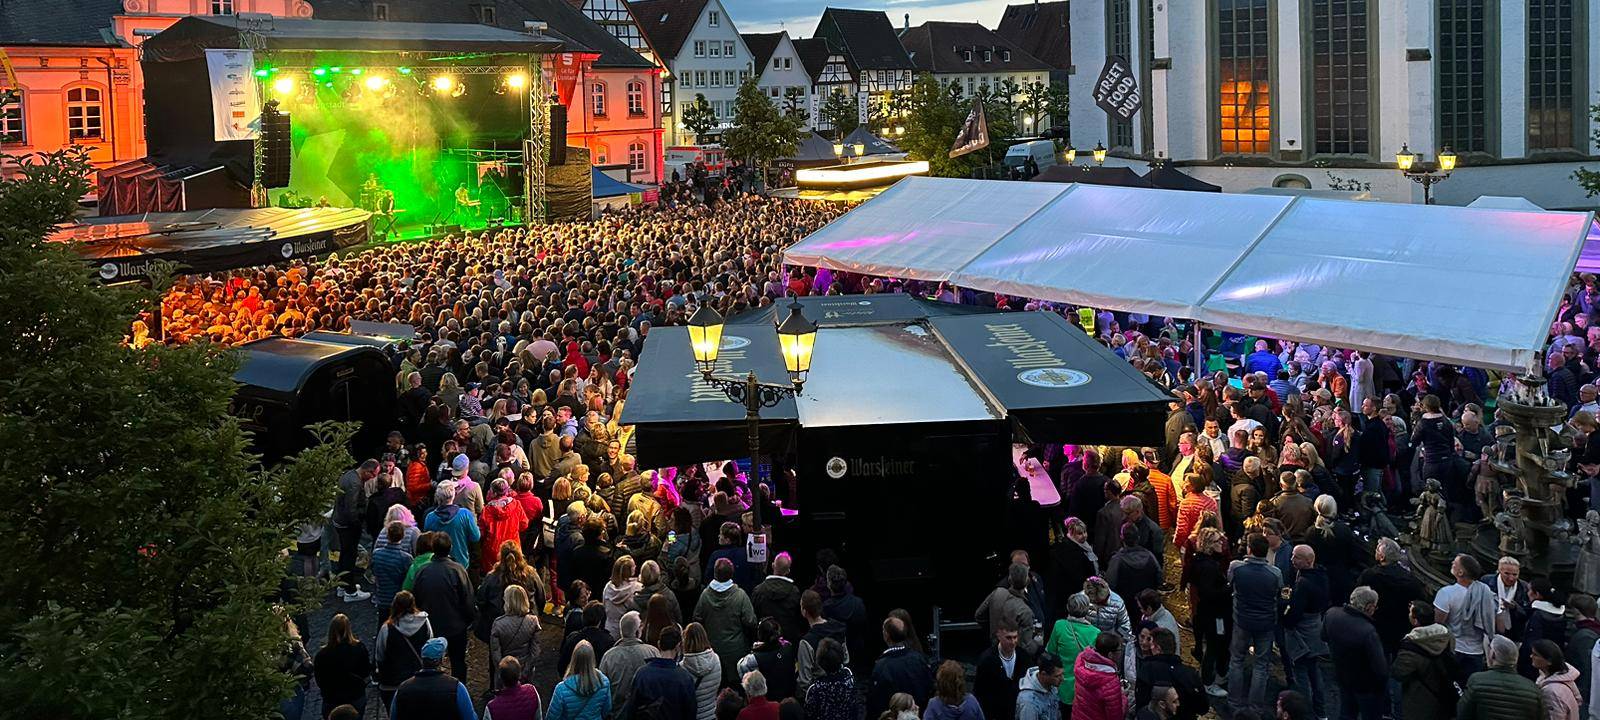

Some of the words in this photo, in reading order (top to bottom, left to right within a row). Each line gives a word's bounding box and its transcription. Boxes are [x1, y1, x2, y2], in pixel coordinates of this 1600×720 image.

[1107, 76, 1134, 107] FOOD
[293, 239, 327, 254] Warsteiner
[984, 323, 1066, 369] Warsteiner
[850, 456, 917, 477] Warsteiner
